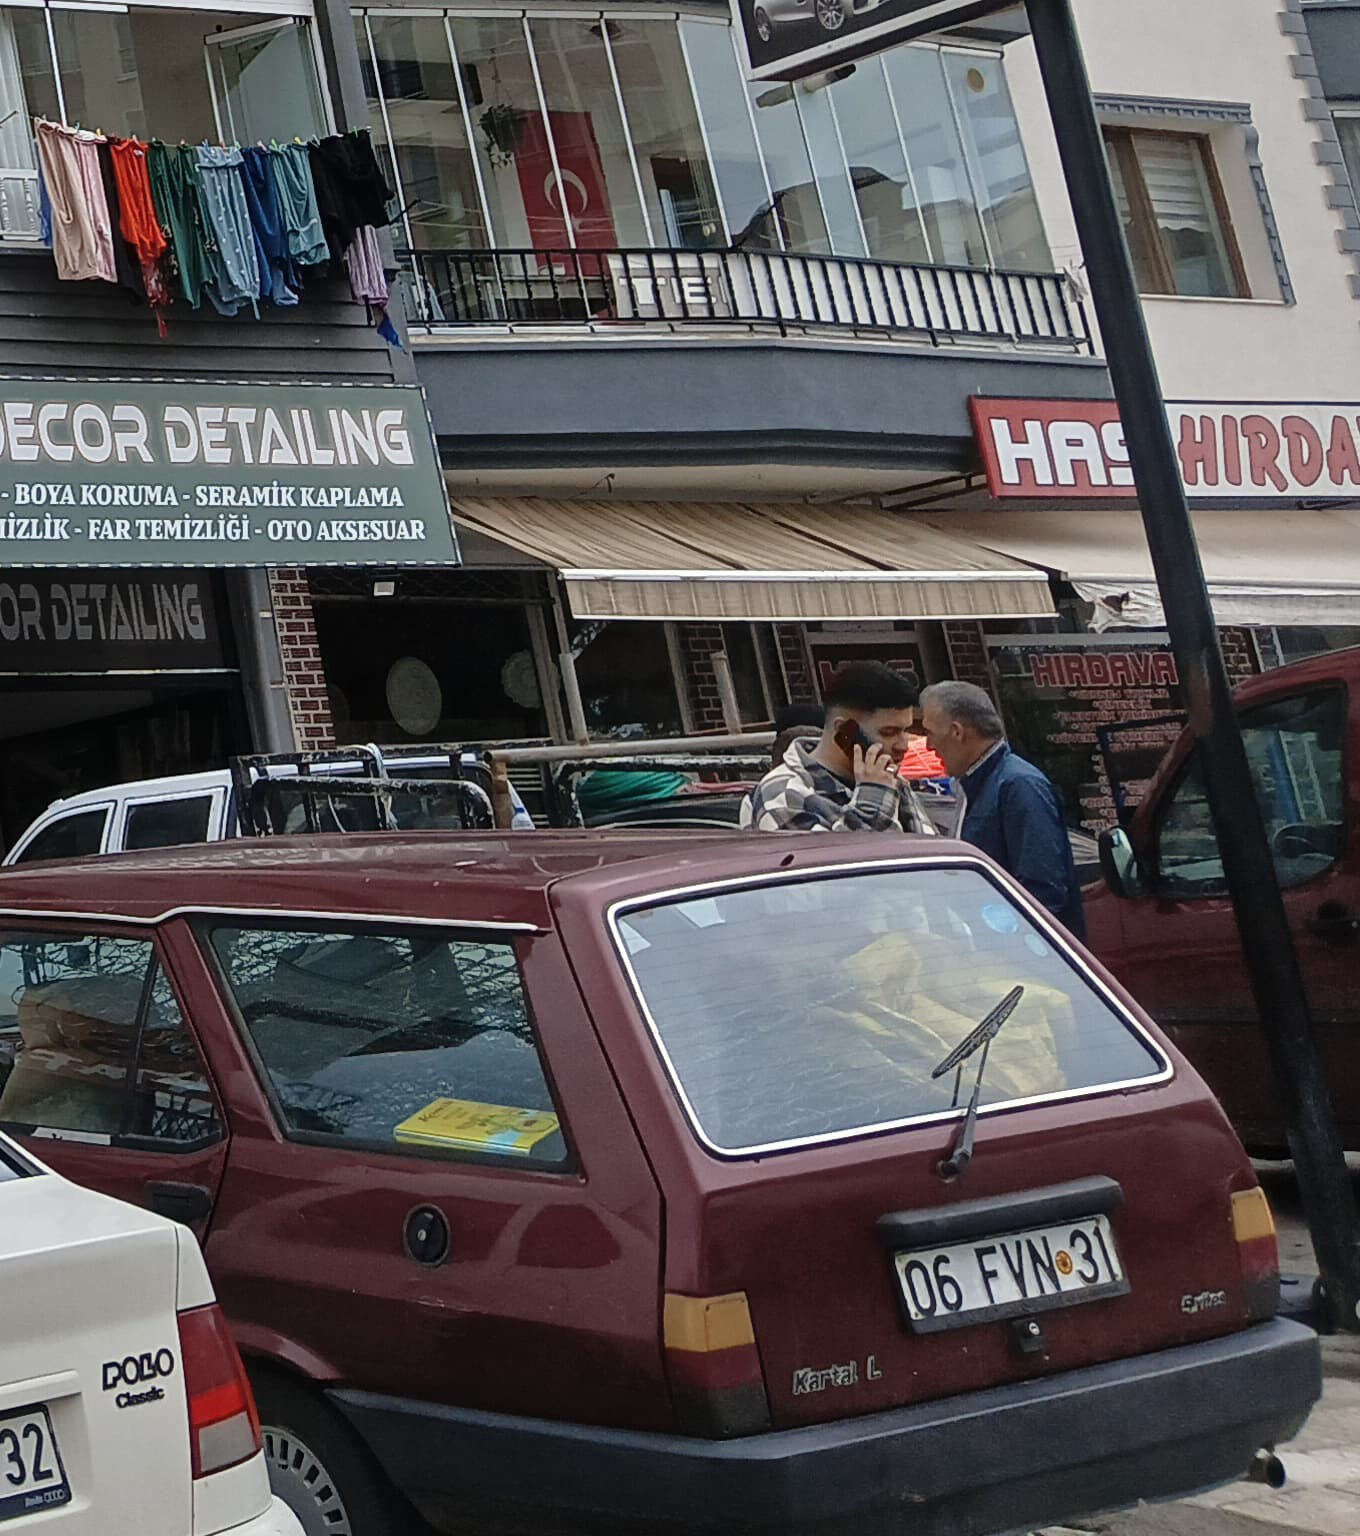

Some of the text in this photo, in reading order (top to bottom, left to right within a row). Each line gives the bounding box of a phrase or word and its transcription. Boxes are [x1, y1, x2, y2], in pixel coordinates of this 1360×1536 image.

[162, 405, 414, 467] DETAILING
[989, 418, 1136, 486] HAS
[1179, 414, 1360, 492] HIRDA
[14, 482, 74, 507] BOYA
[80, 484, 179, 507] KORUMA
[195, 480, 295, 508] SERAMİK
[300, 485, 404, 509] KAPLAMA
[88, 517, 130, 541] FAR
[134, 512, 250, 542] TEMİZLİĞİ
[267, 519, 312, 541] OTO
[316, 519, 426, 542] AKSESUAR
[49, 583, 206, 642] DETAILING
[904, 1226, 1121, 1318] 06 FVN 31
[103, 1348, 174, 1391] POLO
[792, 1356, 882, 1395] Kartal L
